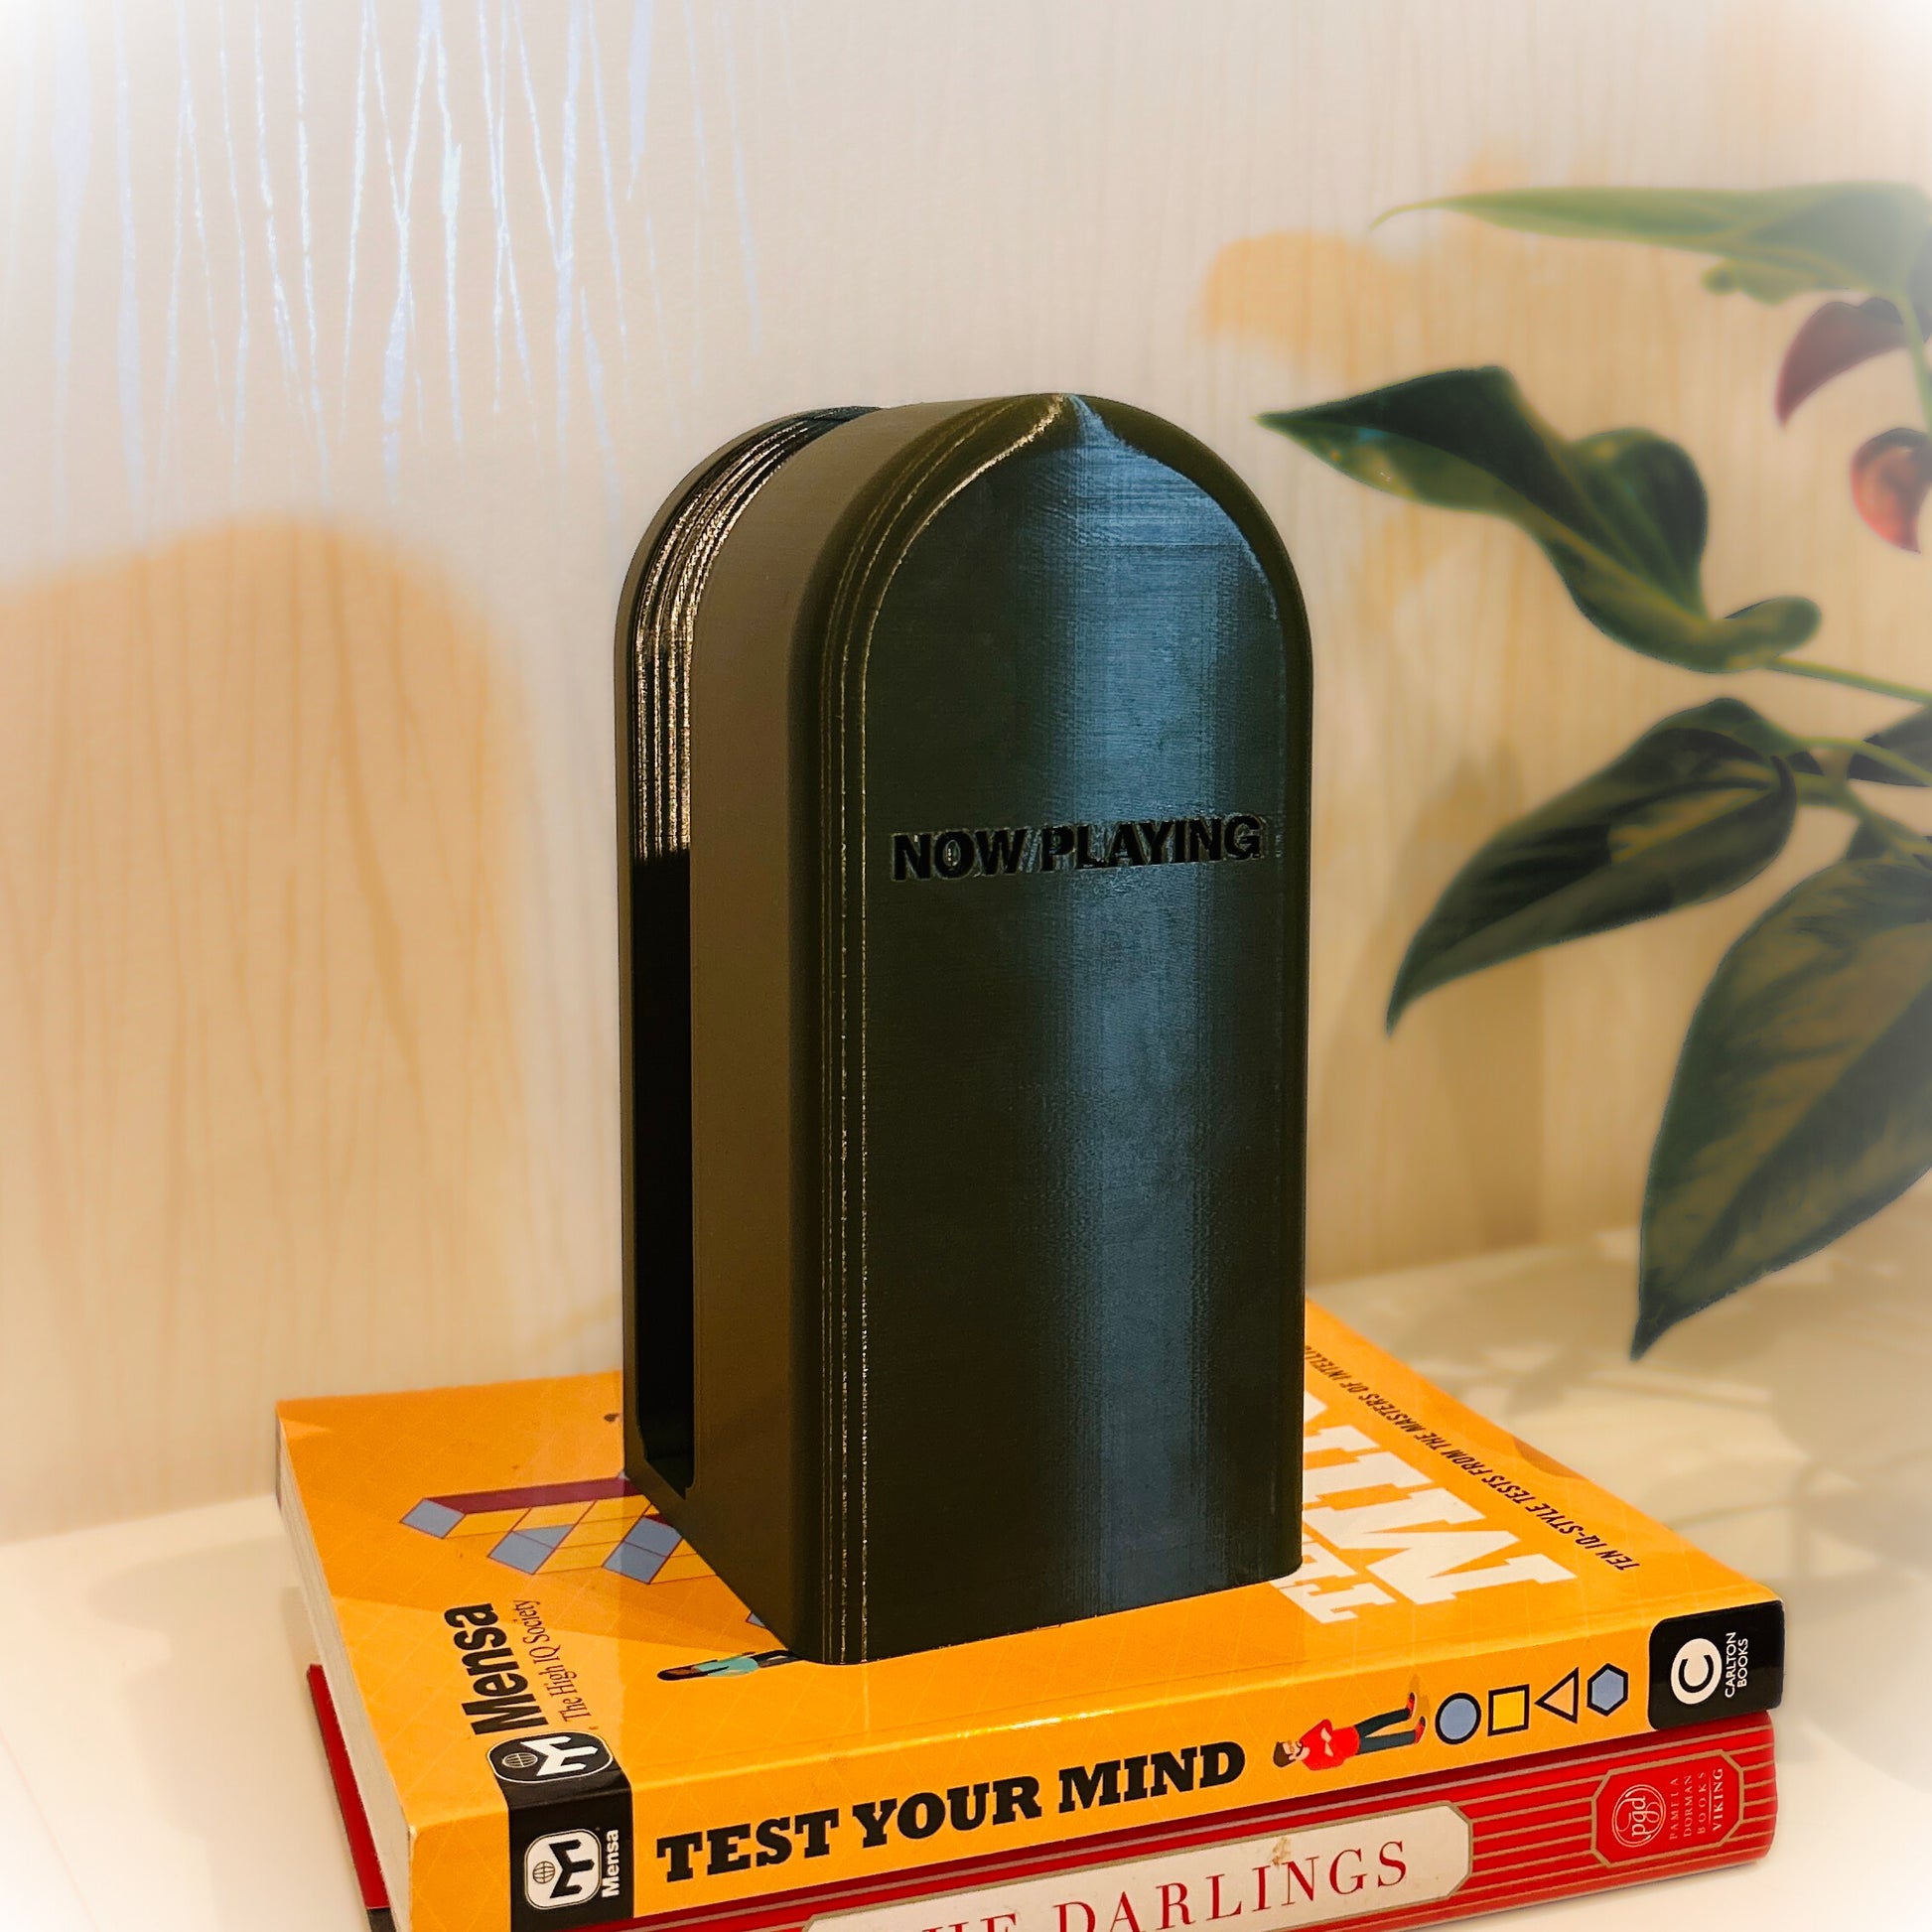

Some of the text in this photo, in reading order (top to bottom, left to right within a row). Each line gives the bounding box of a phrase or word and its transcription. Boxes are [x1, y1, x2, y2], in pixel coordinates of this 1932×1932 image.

[892, 814, 1266, 882] NOW PLAYING
[1338, 1382, 1369, 1394] OF
[1357, 1393, 1427, 1433] MASTERS
[1413, 1432, 1451, 1450] THE
[1440, 1449, 1494, 1476] FROM
[1480, 1475, 1537, 1504] TESTS
[1525, 1502, 1607, 1550] IQ-STYLE
[1594, 1550, 1641, 1571] TEN
[443, 1602, 549, 1735] Mensa
[512, 1599, 592, 1723] The High IQ Society
[1725, 1631, 1736, 1698] CARLTON
[1736, 1638, 1748, 1688] BOOKS
[656, 1740, 1247, 1883] TEST YOUR MIND
[1669, 1777, 1680, 1841] PAMELA
[1683, 1774, 1694, 1838] DORMAN
[1697, 1771, 1708, 1835] BOOKS
[1712, 1768, 1725, 1832] VIKING
[601, 1829, 621, 1898] Mensa
[1052, 1840, 1408, 1932] DARLINGS
